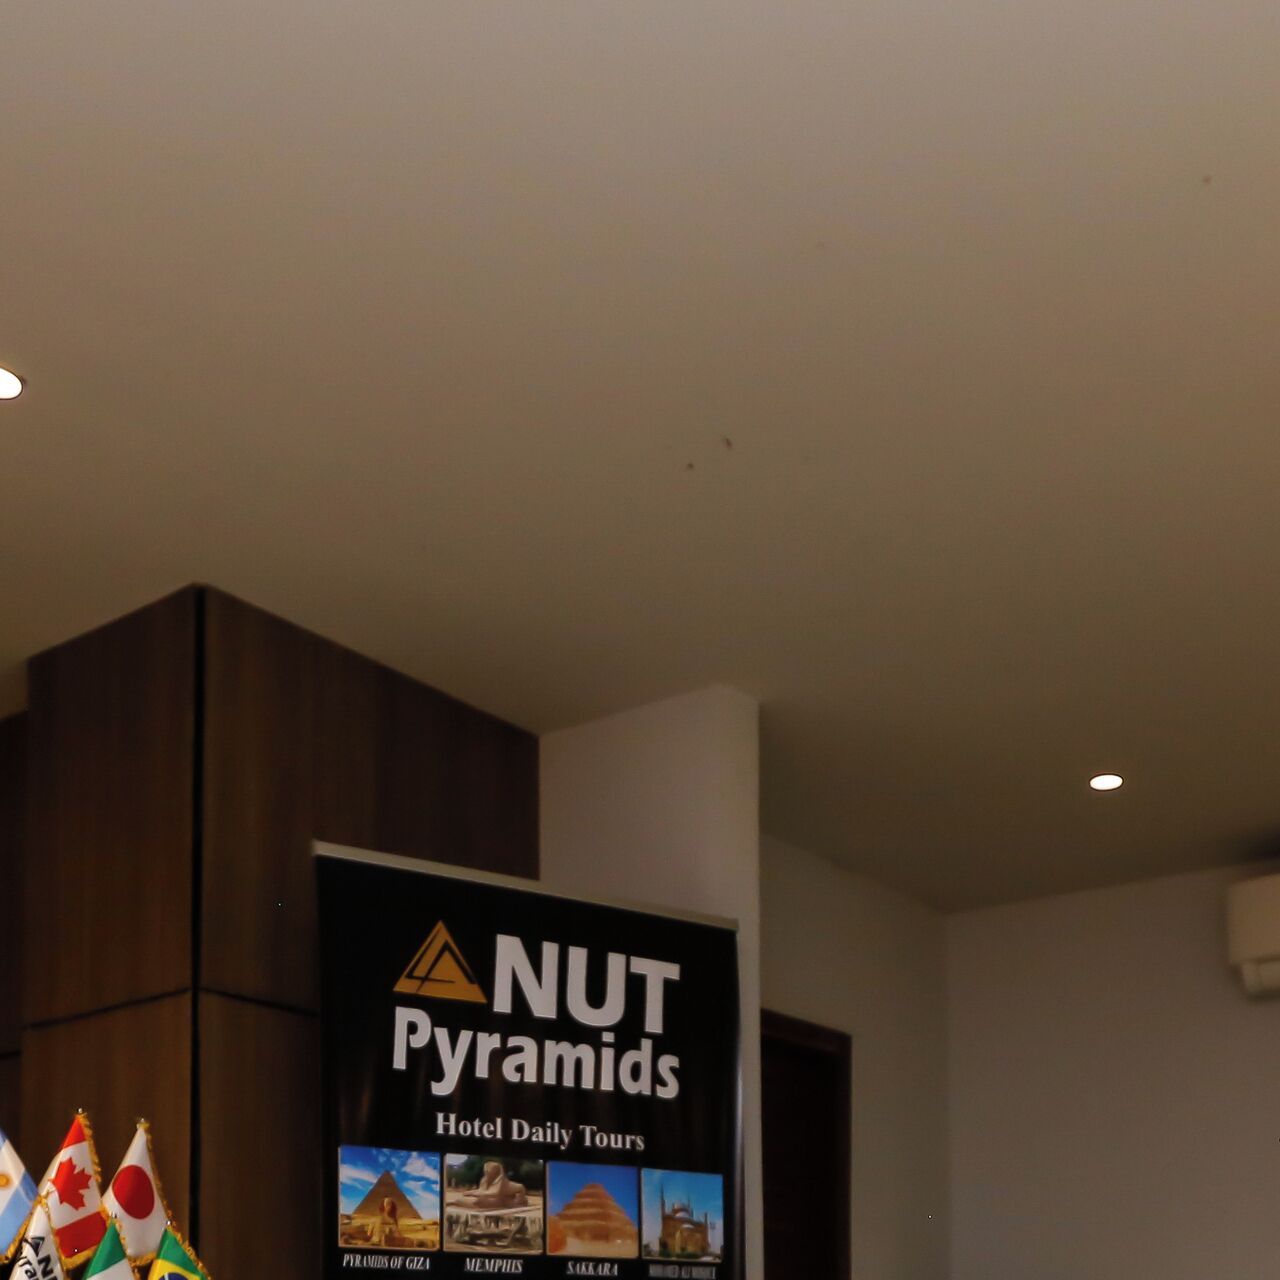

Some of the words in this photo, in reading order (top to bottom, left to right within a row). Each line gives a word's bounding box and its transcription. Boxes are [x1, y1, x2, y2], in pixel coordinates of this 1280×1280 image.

[493, 933, 680, 1034] NUT
[392, 1005, 680, 1099] Pyramids
[435, 1112, 502, 1139] Hotel
[512, 1119, 573, 1150] Daily
[580, 1125, 645, 1150] Tours
[343, 1254, 389, 1269] PYRAMIDS
[390, 1257, 404, 1269] OF
[406, 1257, 430, 1270] GIZA
[464, 1257, 524, 1273] MEMPHIS
[567, 1260, 619, 1276] SAKKARA
